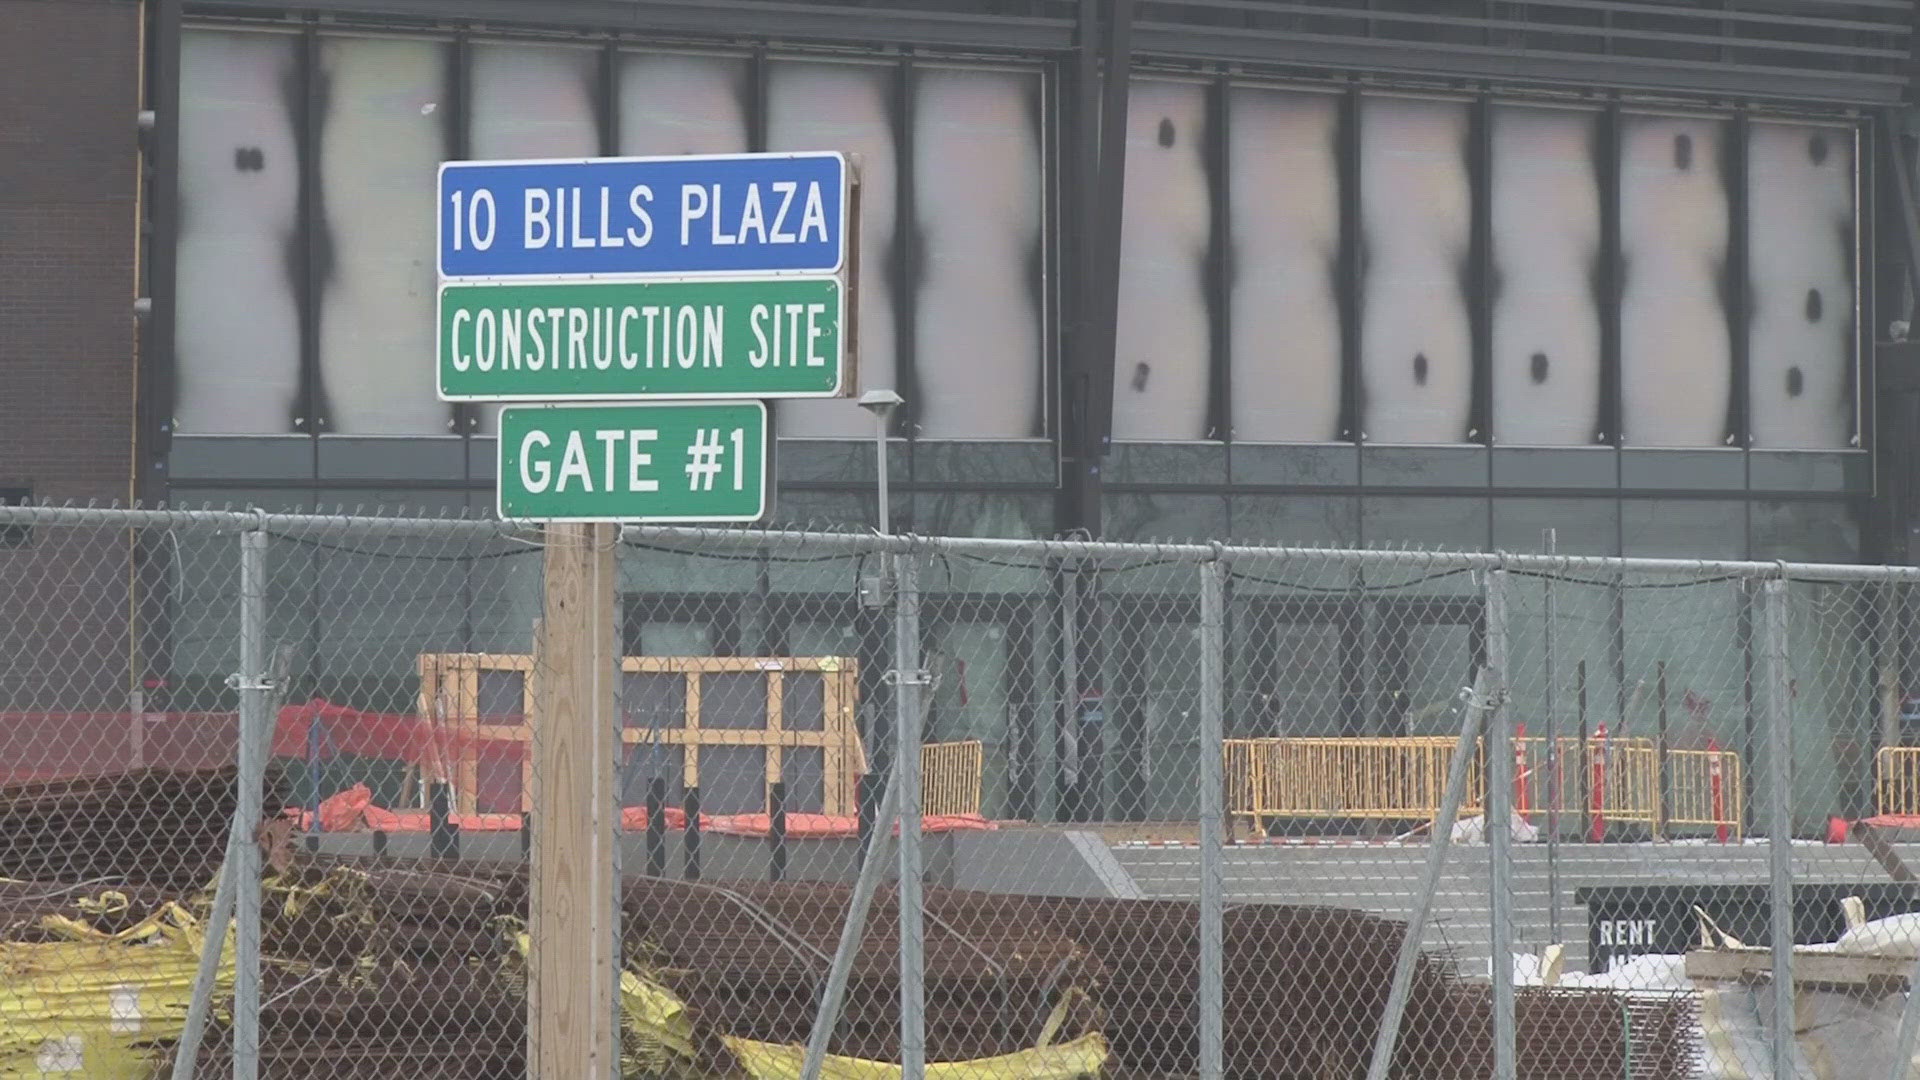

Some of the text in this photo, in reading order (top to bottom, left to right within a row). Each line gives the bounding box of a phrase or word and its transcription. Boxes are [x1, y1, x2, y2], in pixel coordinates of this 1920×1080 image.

[451, 181, 829, 251] 10 BILLS PLAZA
[451, 303, 826, 372] CONSTRUCTION SITE
[519, 427, 744, 494] GATE #1
[1600, 920, 1656, 945] RENT
